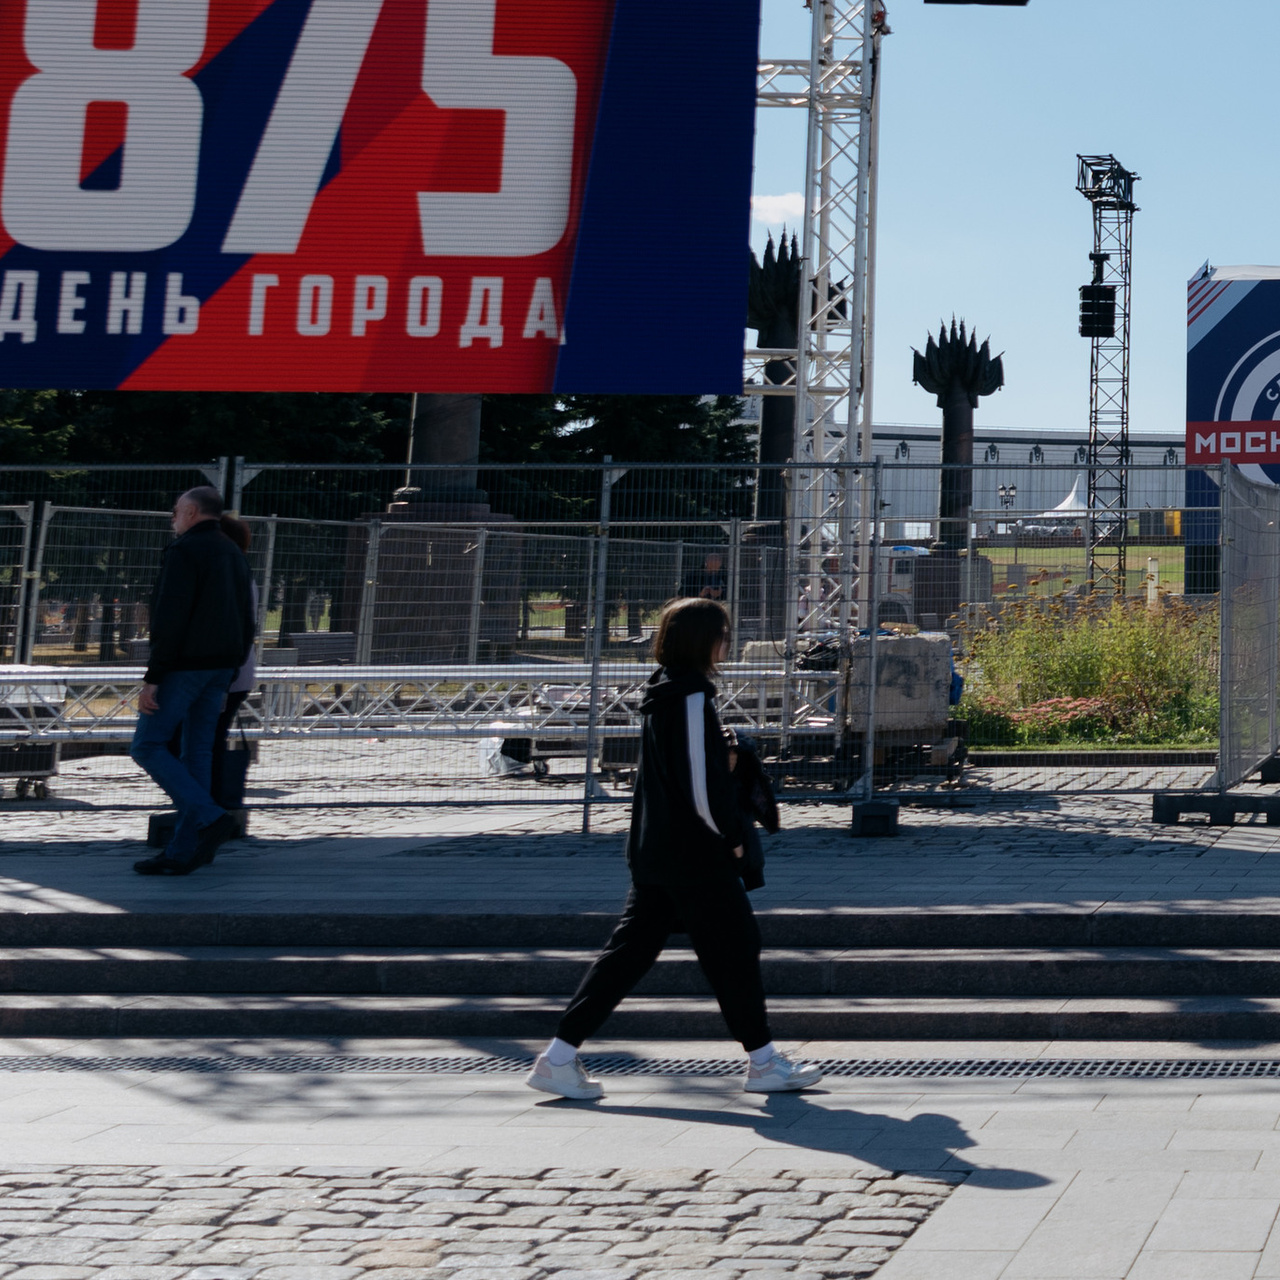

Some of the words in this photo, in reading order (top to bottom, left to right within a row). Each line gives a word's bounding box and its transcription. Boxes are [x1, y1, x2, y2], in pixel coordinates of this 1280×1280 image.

[0, 270, 201, 344] ДЕНЬ
[247, 273, 568, 349] ГОРОДА
[1266, 388, 1279, 402] С
